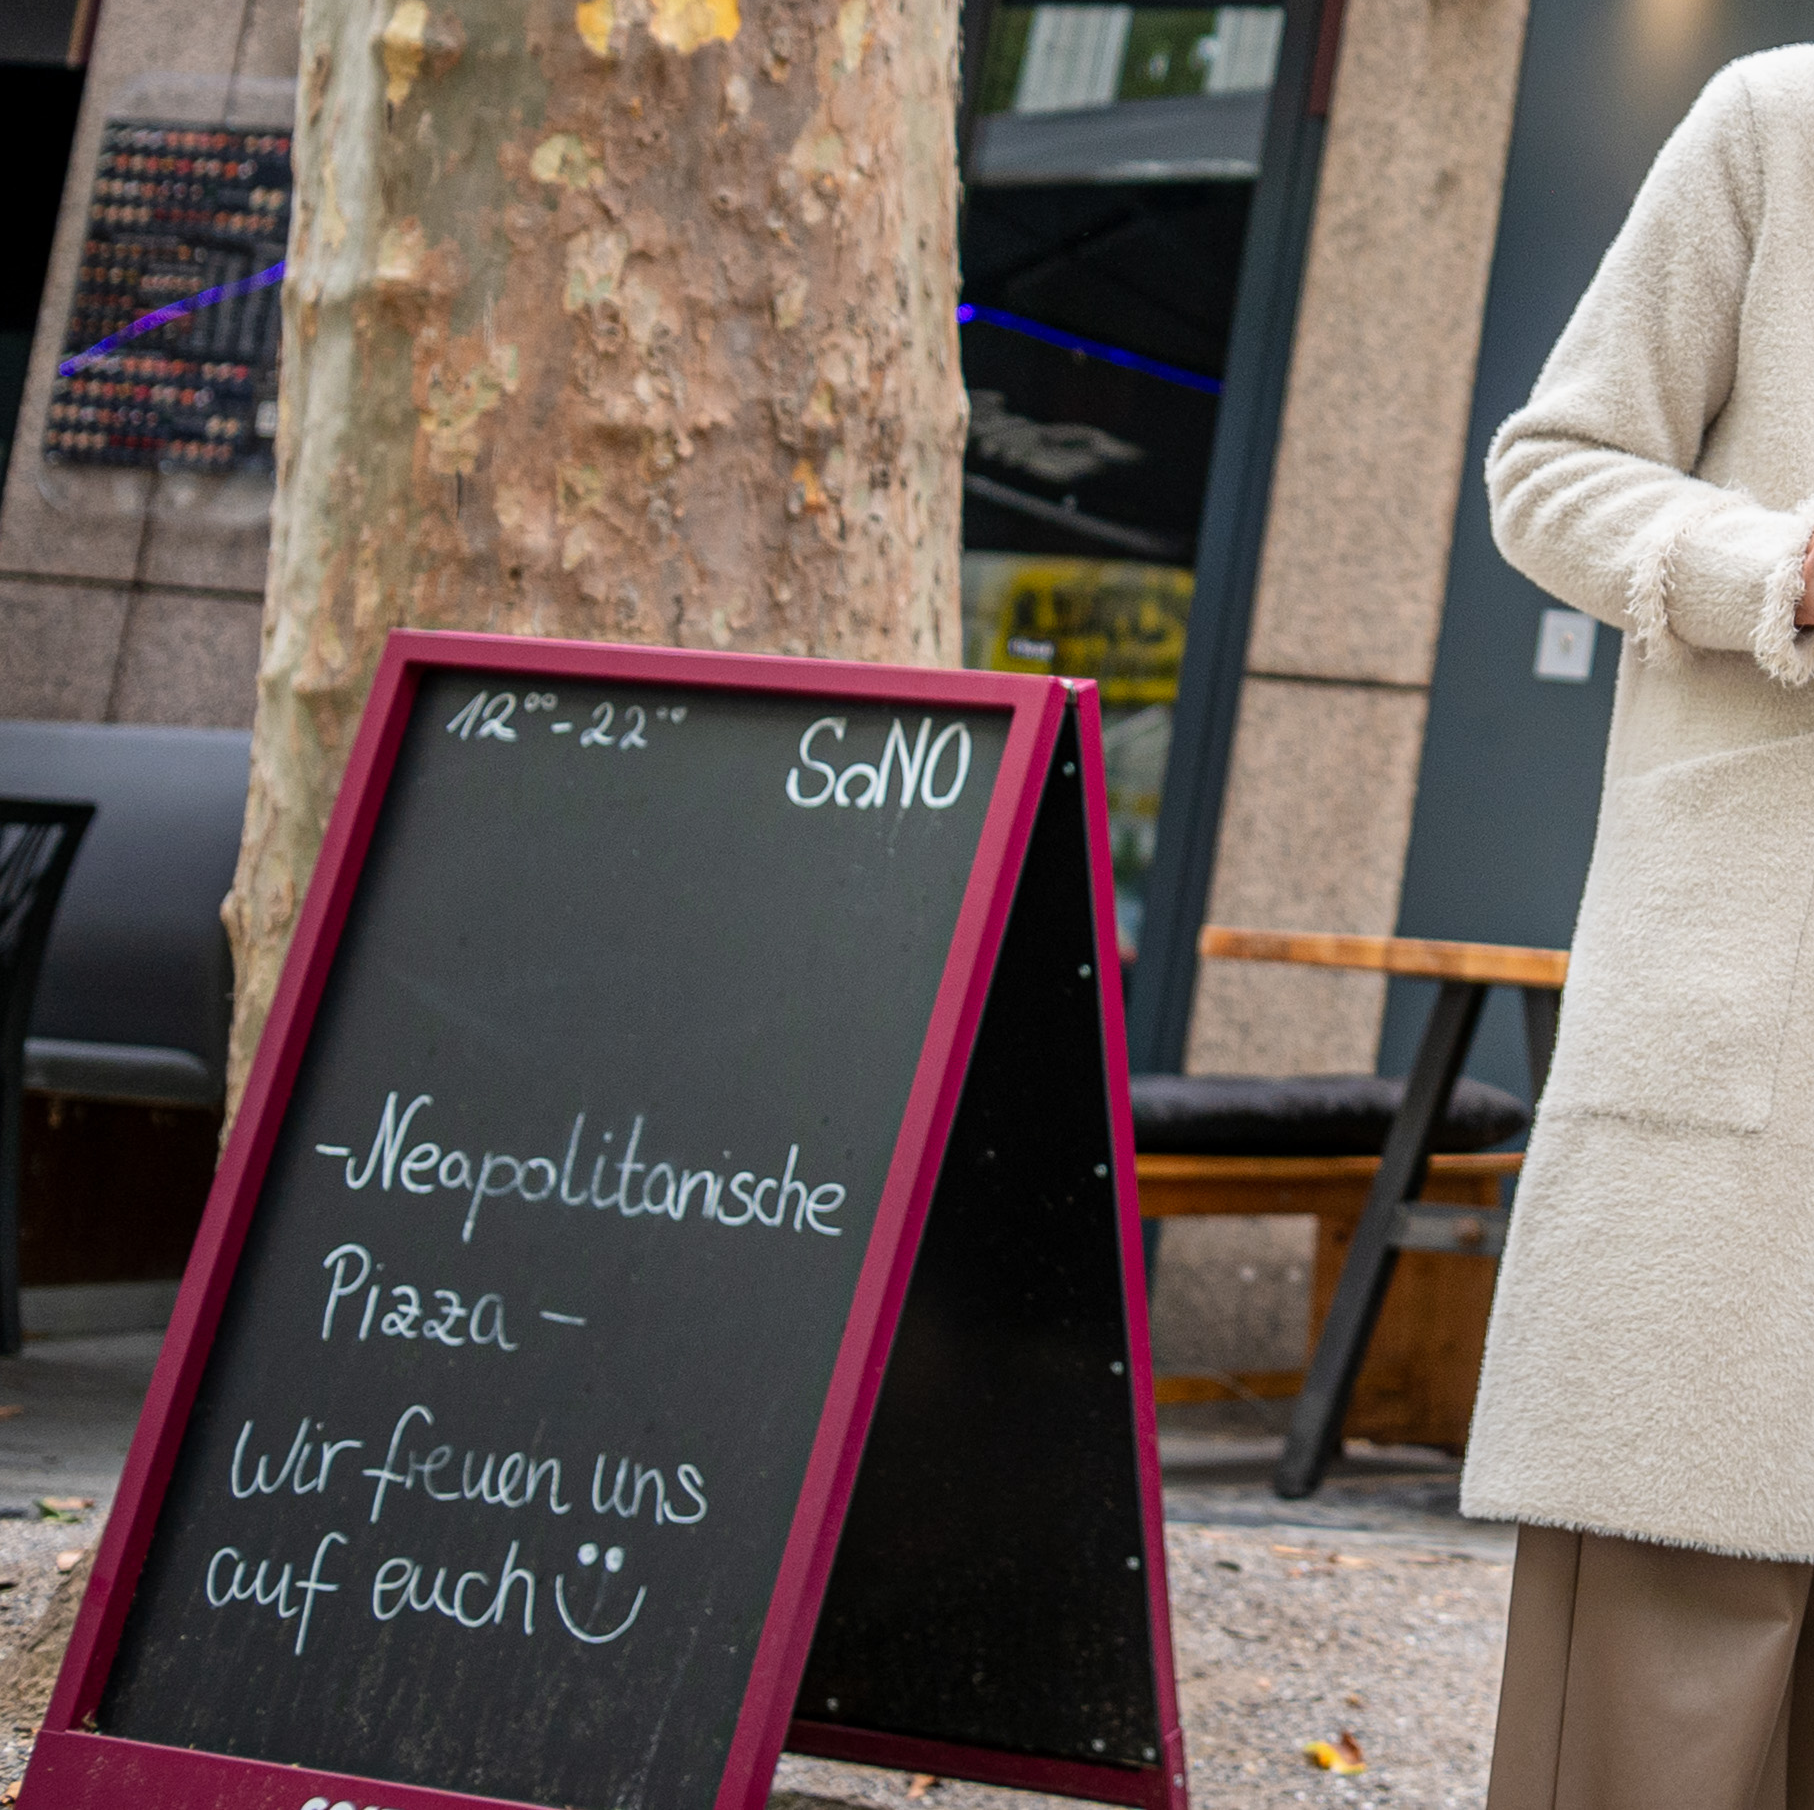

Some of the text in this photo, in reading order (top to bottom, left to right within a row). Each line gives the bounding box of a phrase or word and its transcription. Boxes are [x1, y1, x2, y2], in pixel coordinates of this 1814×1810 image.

[231, 1416, 363, 1500] Wir
[592, 1453, 708, 1526] uns
[205, 1531, 535, 1657] auf euch
